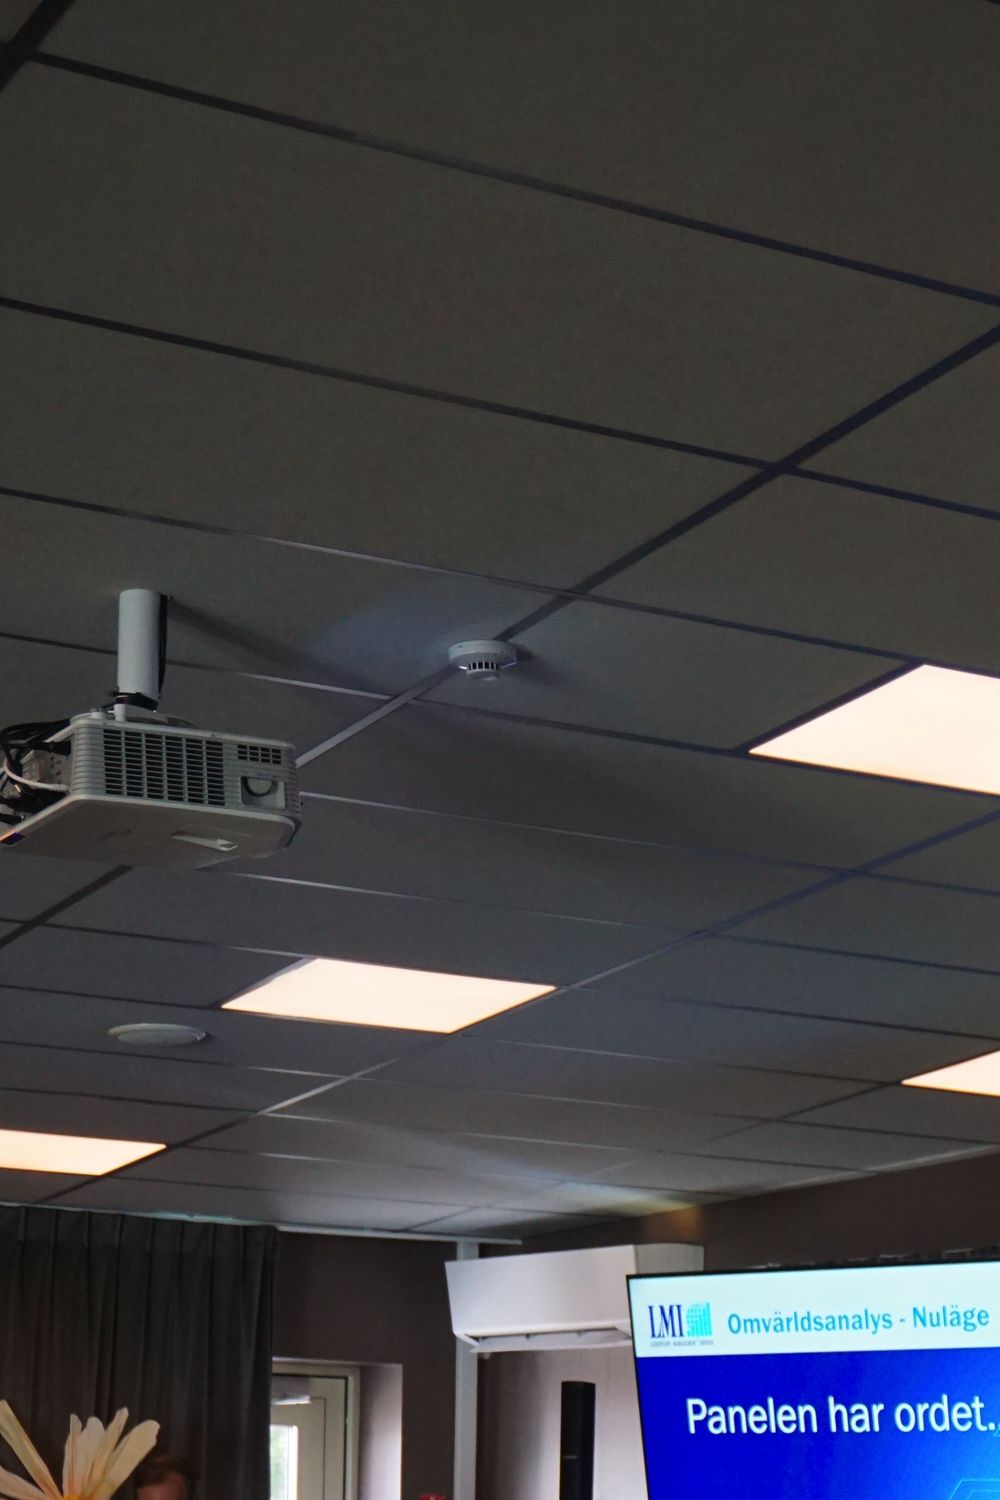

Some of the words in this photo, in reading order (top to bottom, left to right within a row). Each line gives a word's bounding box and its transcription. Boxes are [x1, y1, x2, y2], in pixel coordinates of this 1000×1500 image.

[648, 1304, 685, 1339] LMI
[728, 1309, 893, 1334] Omvärldsanalys
[912, 1304, 990, 1332] Nuläge
[686, 1396, 817, 1434] Panelen
[827, 1395, 884, 1433] har
